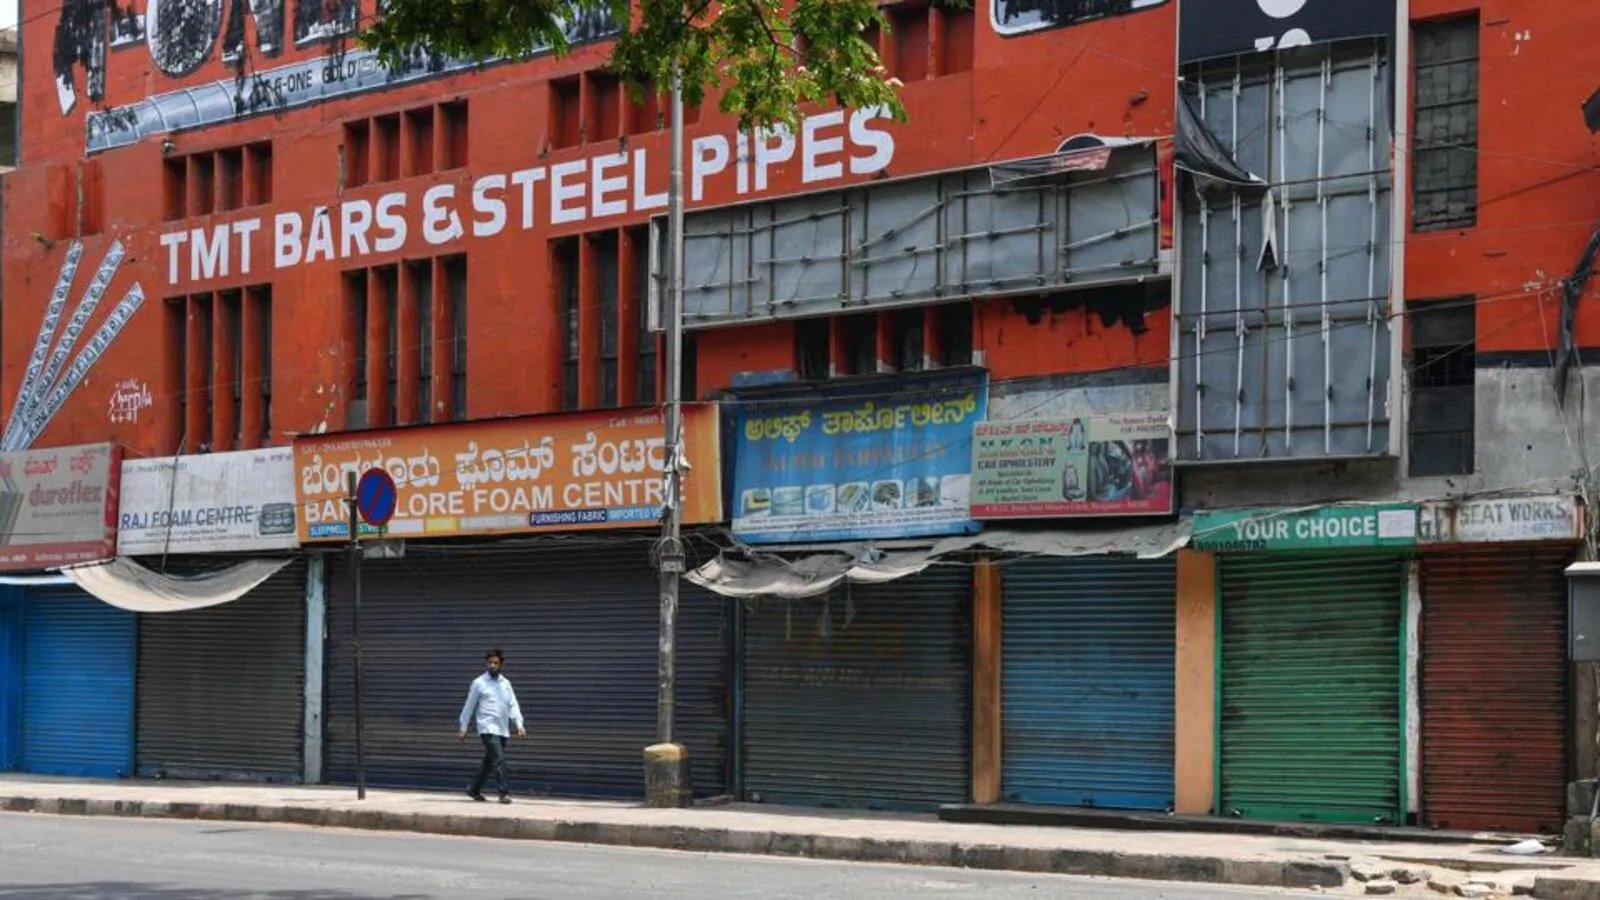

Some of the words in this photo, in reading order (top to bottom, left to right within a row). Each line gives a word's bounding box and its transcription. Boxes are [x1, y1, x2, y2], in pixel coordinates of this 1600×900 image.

[160, 218, 261, 285] TMT
[274, 192, 406, 270] BARS
[421, 183, 464, 246] &
[471, 149, 669, 238] STEEL
[691, 104, 894, 201] PIPES
[304, 491, 464, 523] BANLORE
[473, 486, 554, 514] FOAM
[563, 477, 686, 507] CENTR
[121, 511, 148, 530] RAJ
[151, 508, 192, 528] FOAM
[196, 505, 252, 526] CENTRE
[577, 510, 606, 523] FABRIC
[1459, 503, 1505, 525] SEAT
[1233, 519, 1289, 541] YOUR
[1295, 515, 1376, 538] CHOICE
